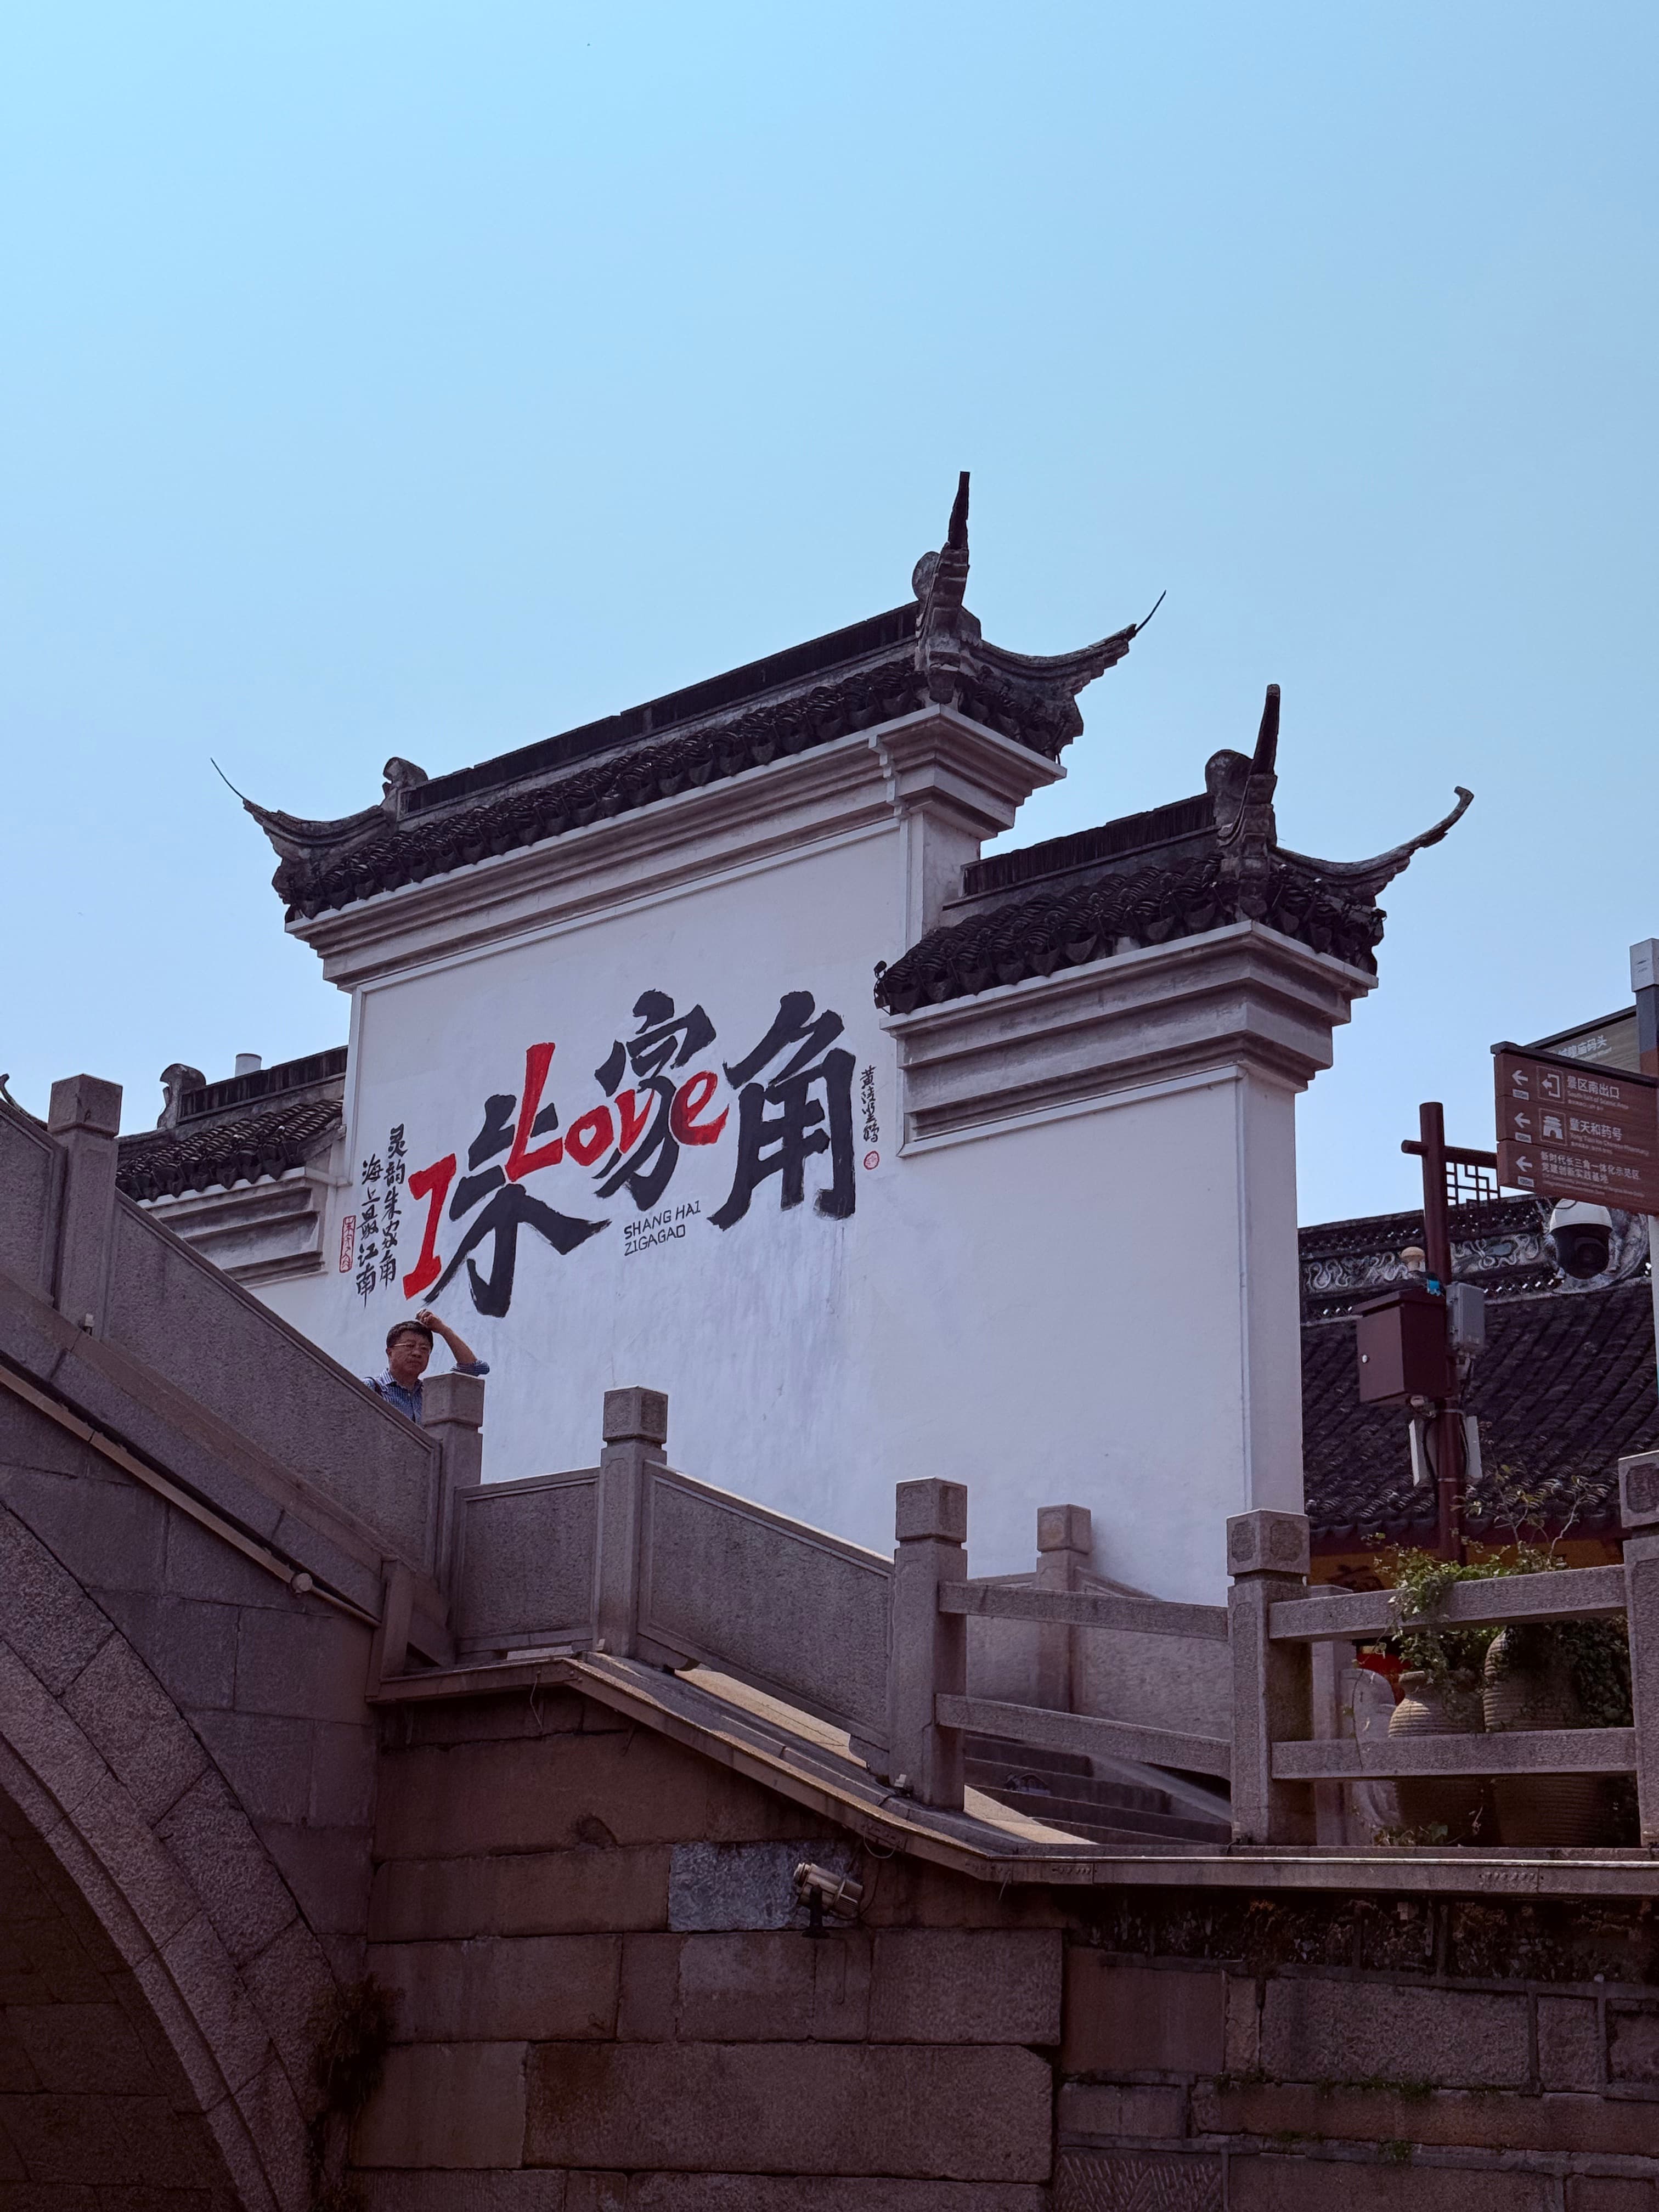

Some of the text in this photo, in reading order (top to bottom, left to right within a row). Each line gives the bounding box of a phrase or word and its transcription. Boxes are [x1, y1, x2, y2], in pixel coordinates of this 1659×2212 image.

[422, 989, 856, 1318] 朱家角
[1567, 1075, 1620, 1099] 景区南出口
[356, 1153, 383, 1308] 海上最江南
[380, 1123, 408, 1290] 灵韵朱家角
[624, 1200, 701, 1240] SHANG HAI
